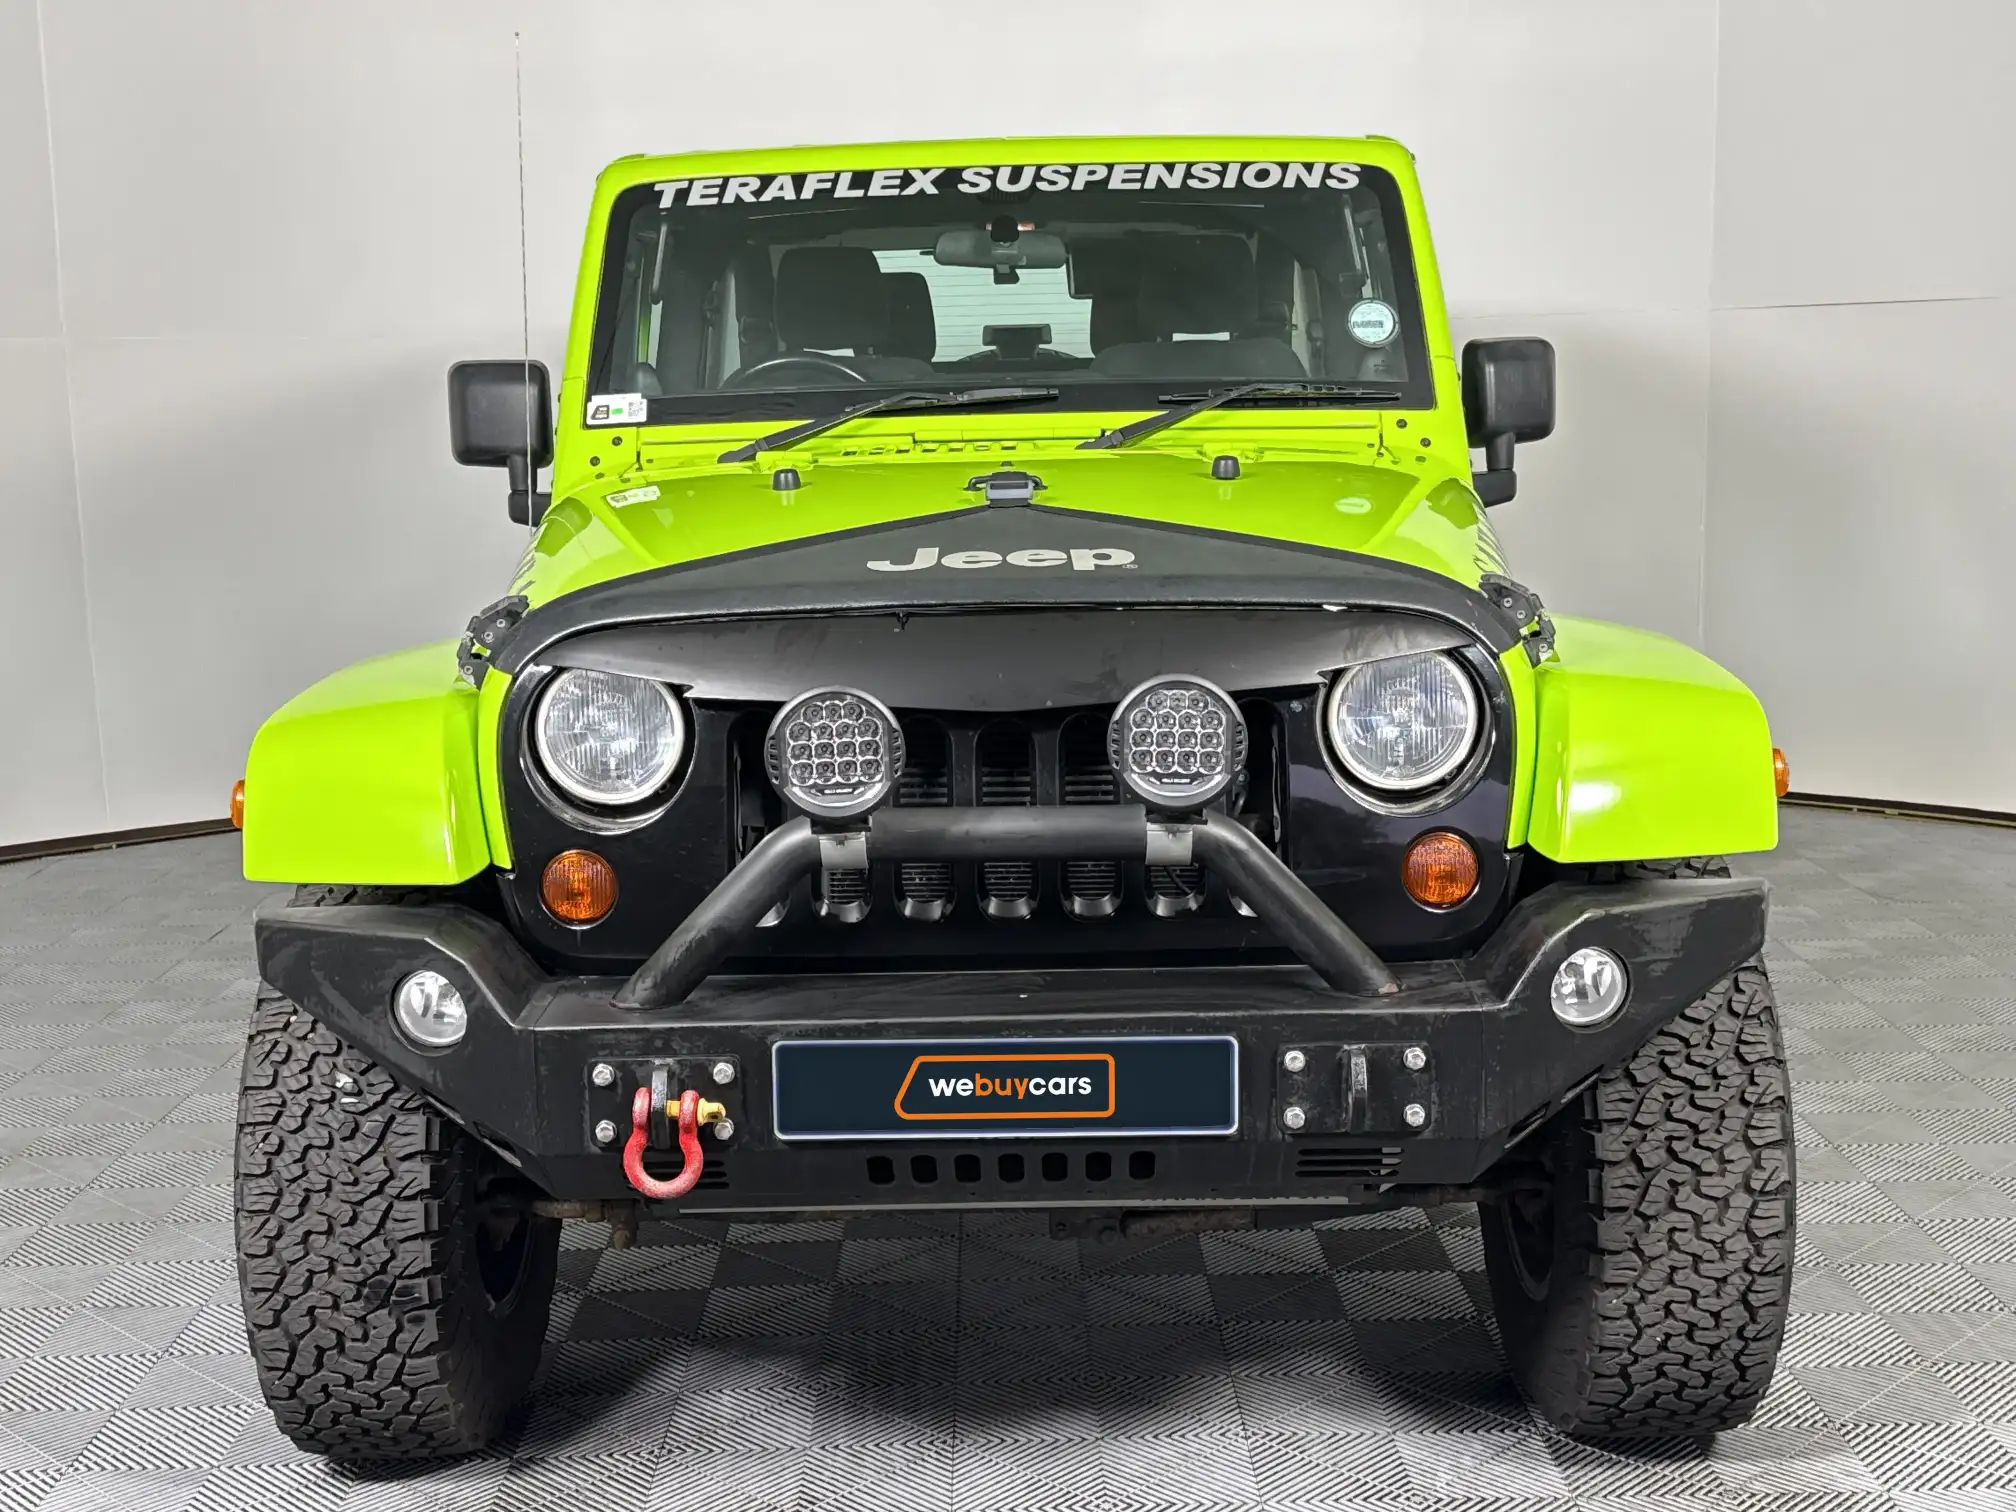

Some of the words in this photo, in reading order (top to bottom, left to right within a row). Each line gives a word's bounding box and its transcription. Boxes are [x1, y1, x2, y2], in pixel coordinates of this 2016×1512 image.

[653, 168, 946, 209] TERAFLEX
[957, 162, 1362, 194] SUSPENSIONS
[866, 546, 1136, 571] Jeep
[927, 1073, 1092, 1099] webuycars
